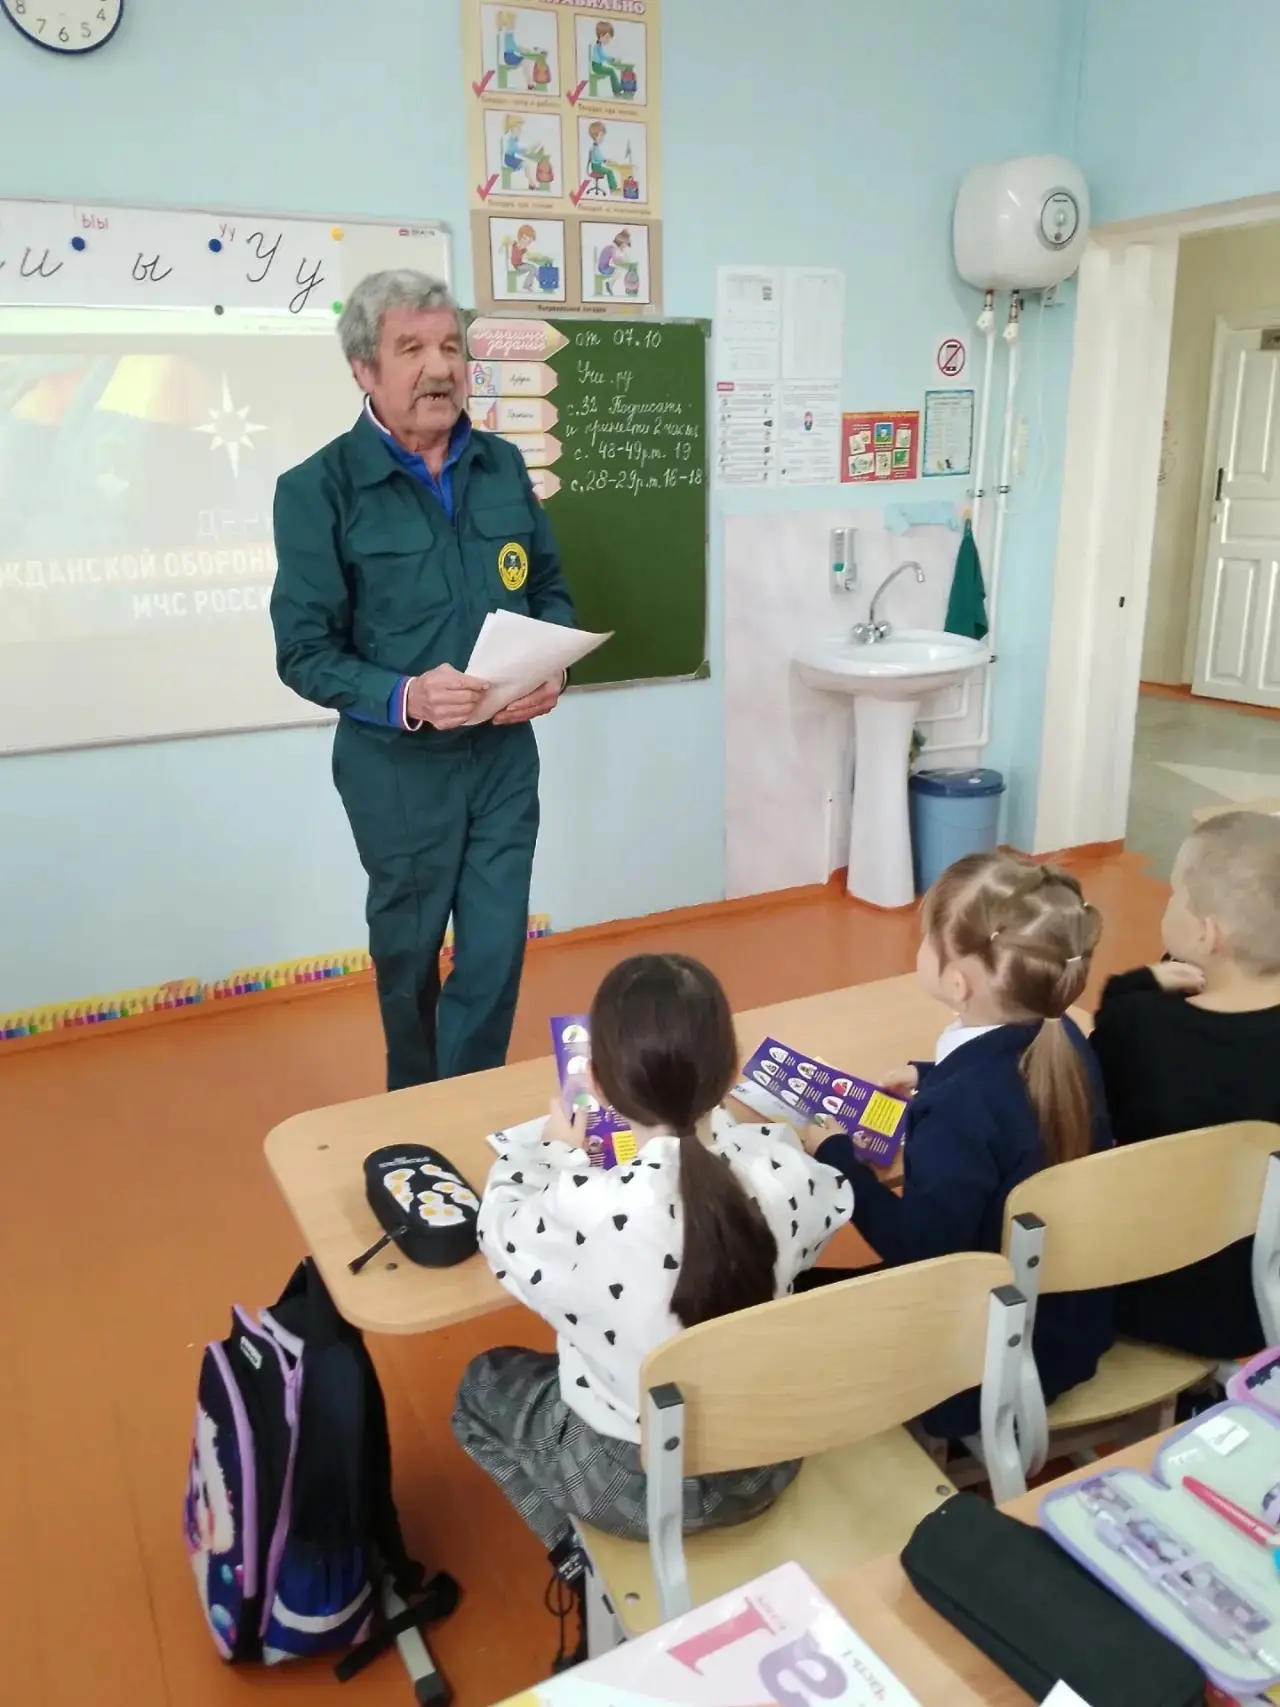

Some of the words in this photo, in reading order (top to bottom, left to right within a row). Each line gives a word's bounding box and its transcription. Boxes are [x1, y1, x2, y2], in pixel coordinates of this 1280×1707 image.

[96, 8, 106, 21] 4
[36, 18, 46, 34] 7
[58, 26, 69, 42] 6
[80, 22, 91, 38] 5
[613, 328, 662, 348] 07.10
